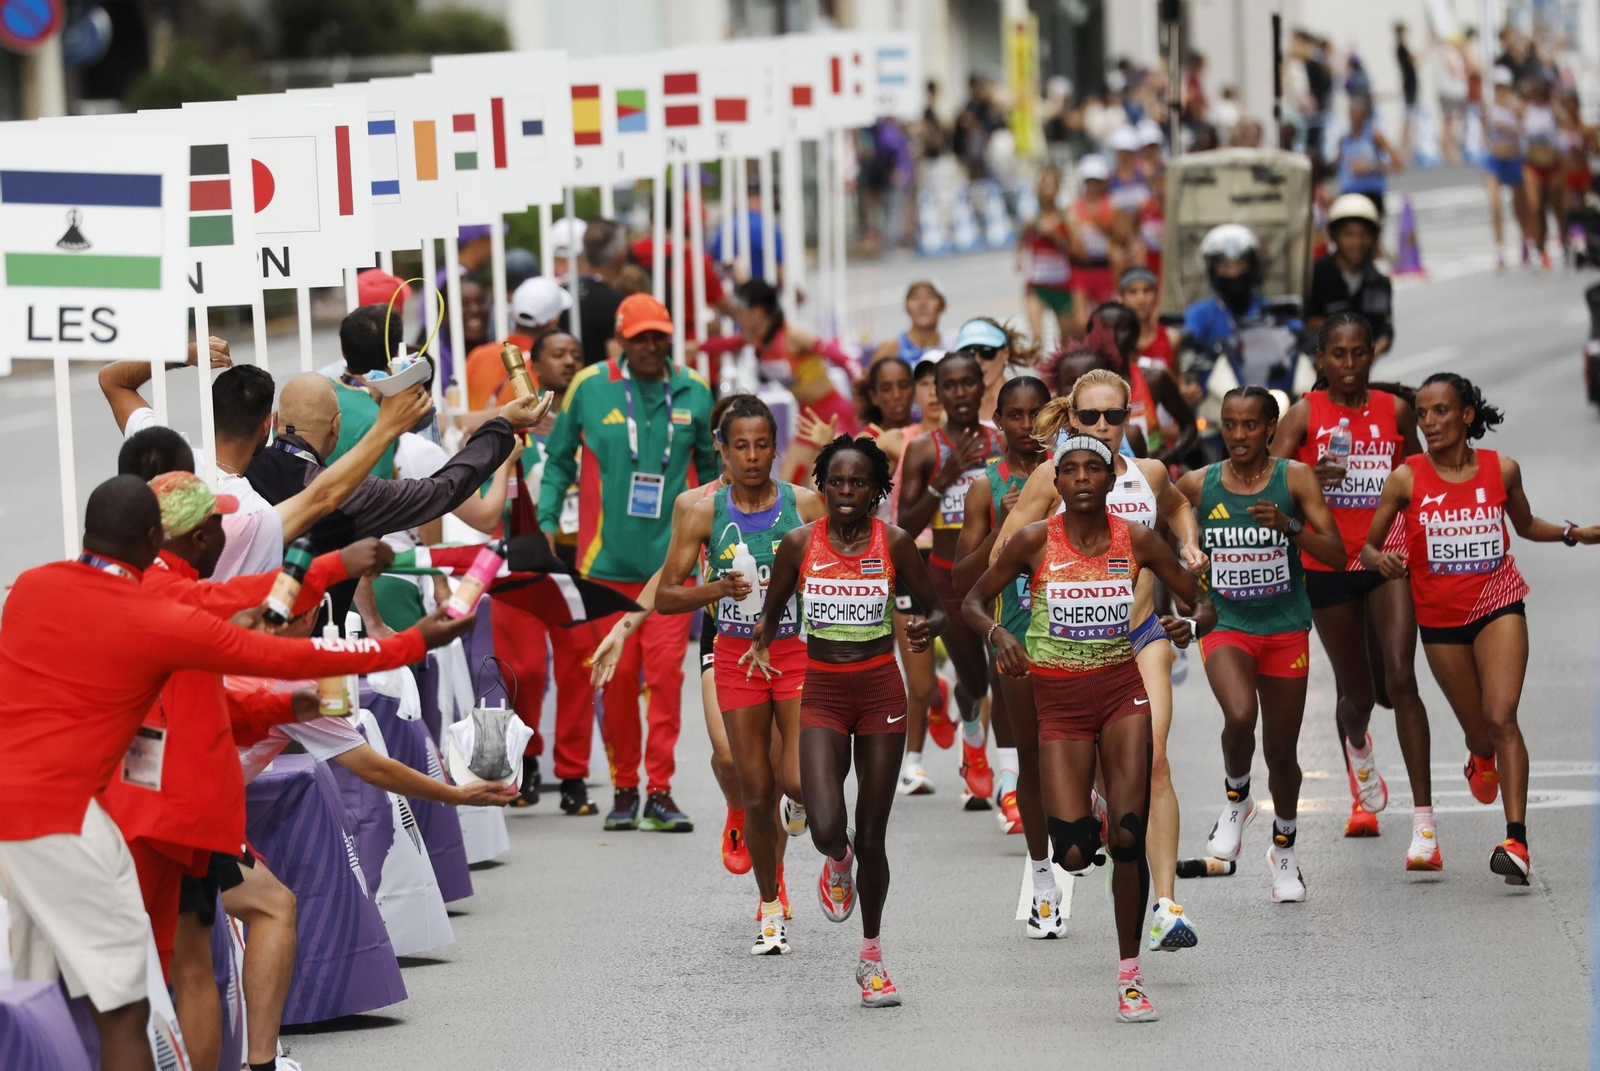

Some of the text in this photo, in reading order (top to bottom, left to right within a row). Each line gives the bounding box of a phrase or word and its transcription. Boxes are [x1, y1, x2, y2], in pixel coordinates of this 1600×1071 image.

[27, 305, 119, 343] LES
[1349, 460, 1389, 470] NDA
[1418, 505, 1503, 526] BAHRAIN
[1204, 526, 1290, 549] ETHIOPIA
[1427, 523, 1501, 537] HONDA
[1212, 548, 1286, 564] HONDA
[1431, 539, 1501, 559] ESHETE
[1216, 564, 1286, 586] KEBEDE
[806, 583, 887, 597] HONDA
[1049, 585, 1131, 599] HONDA
[806, 602, 884, 622] JEPCHIRCHIR
[1052, 603, 1129, 624] CHERONO
